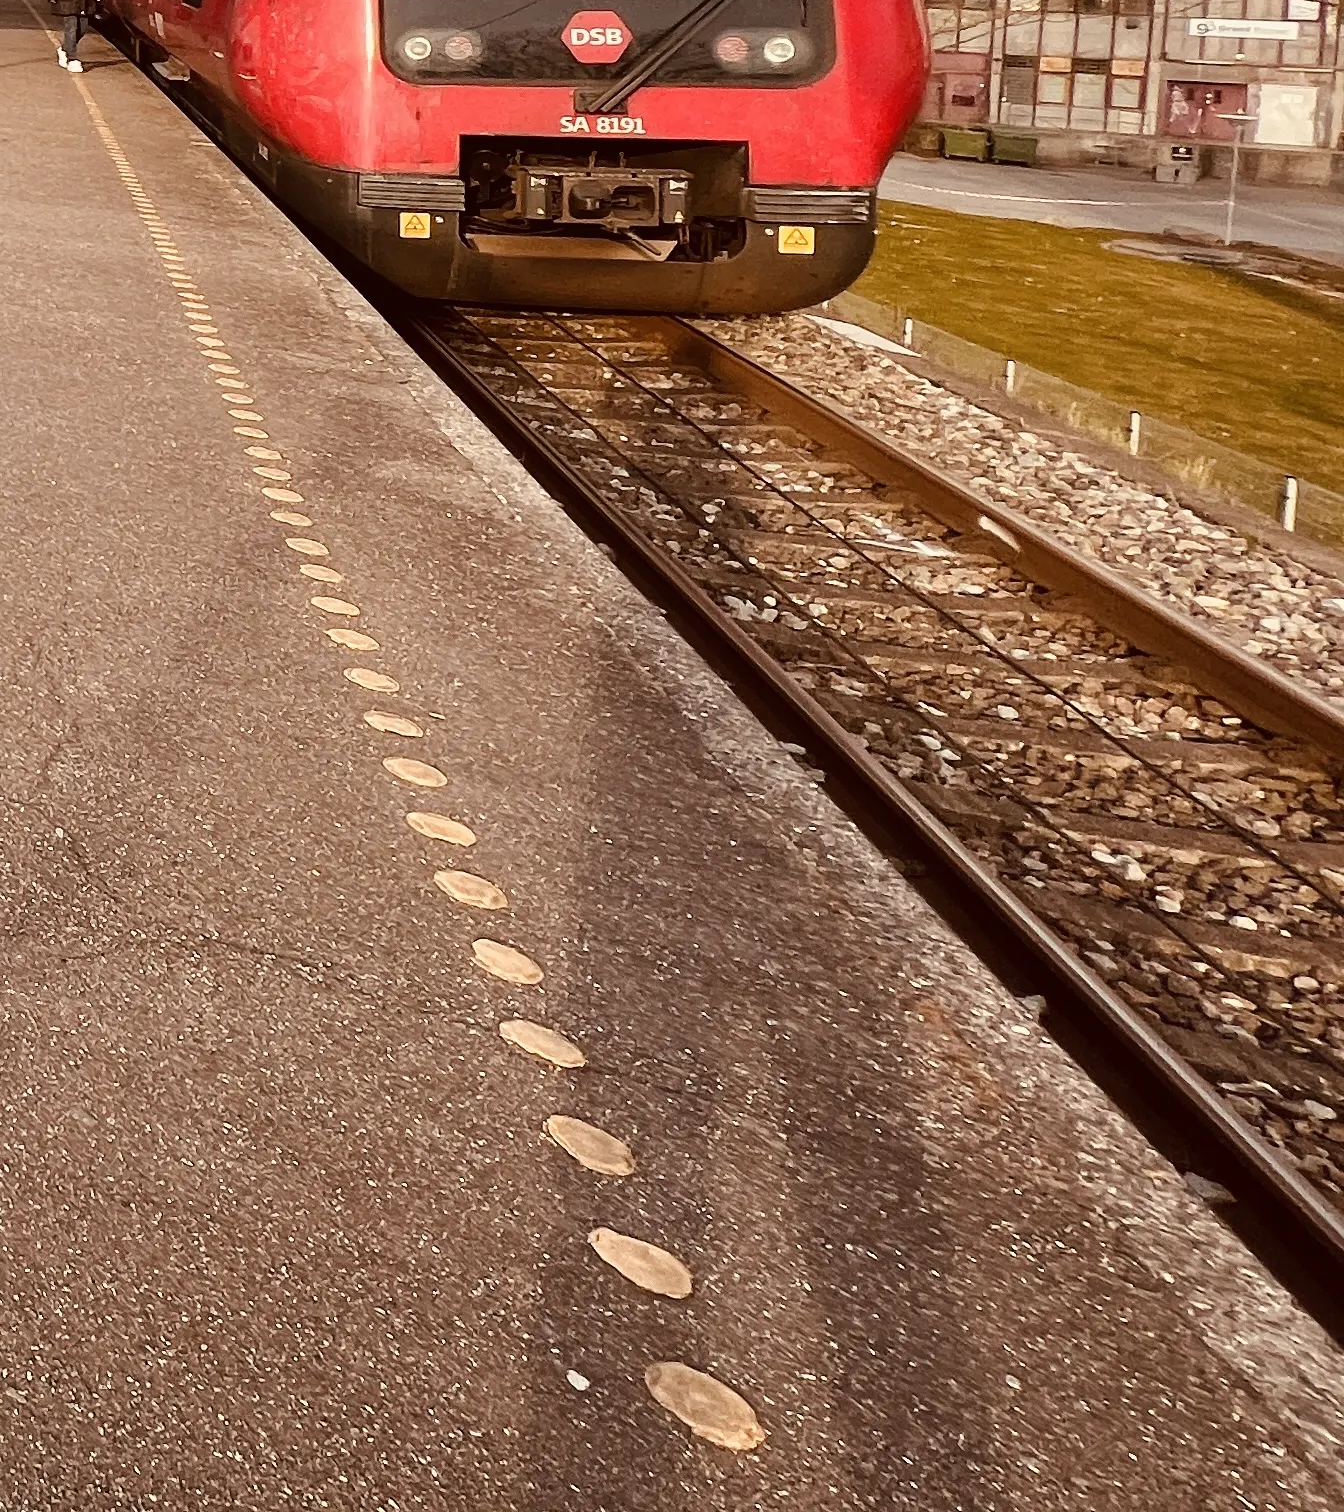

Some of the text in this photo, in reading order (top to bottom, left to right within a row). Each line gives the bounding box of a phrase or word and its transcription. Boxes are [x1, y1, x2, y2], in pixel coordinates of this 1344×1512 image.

[569, 28, 624, 46] DSB
[559, 116, 647, 135] SA 8191
